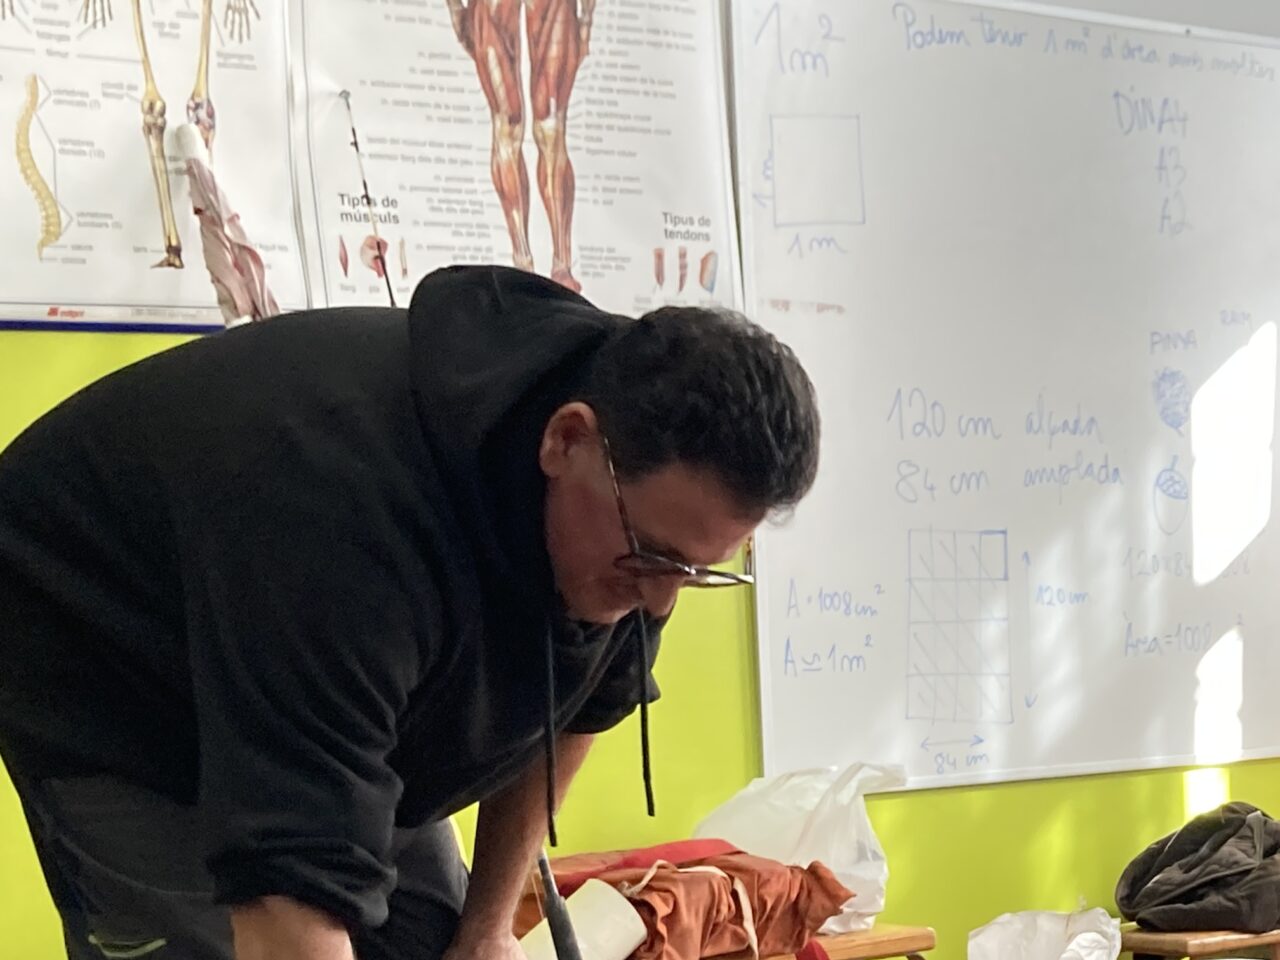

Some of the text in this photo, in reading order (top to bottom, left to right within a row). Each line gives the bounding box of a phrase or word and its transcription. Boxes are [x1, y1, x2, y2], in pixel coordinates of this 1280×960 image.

[381, 196, 398, 209] de
[662, 211, 711, 228] Tipus de
[664, 228, 710, 242] tendons
[887, 387, 946, 441] 120
[895, 459, 937, 503] 84
